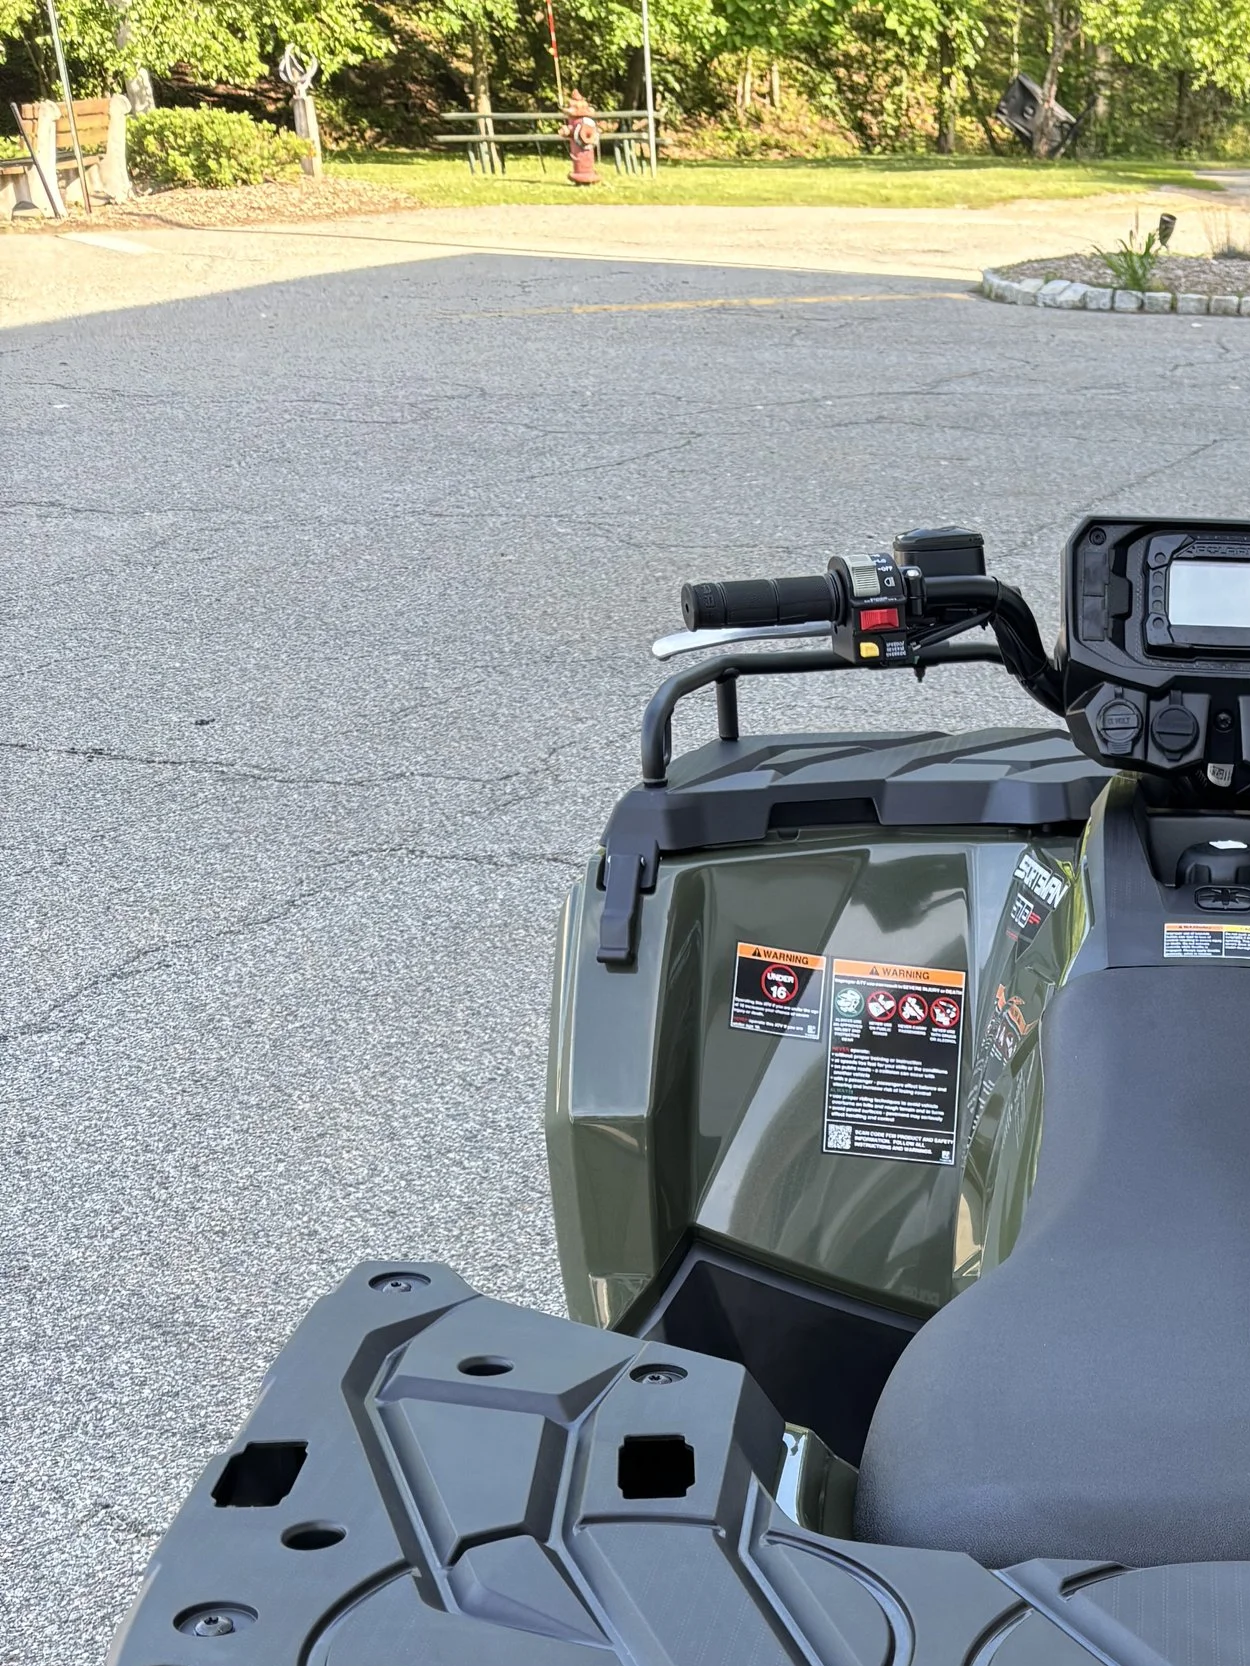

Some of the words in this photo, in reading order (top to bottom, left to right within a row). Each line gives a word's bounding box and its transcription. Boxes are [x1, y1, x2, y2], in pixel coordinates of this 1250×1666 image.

[763, 949, 809, 965] WARNING
[766, 972, 795, 984] UNDER
[882, 966, 930, 981] WARNING
[770, 985, 787, 999] 16
